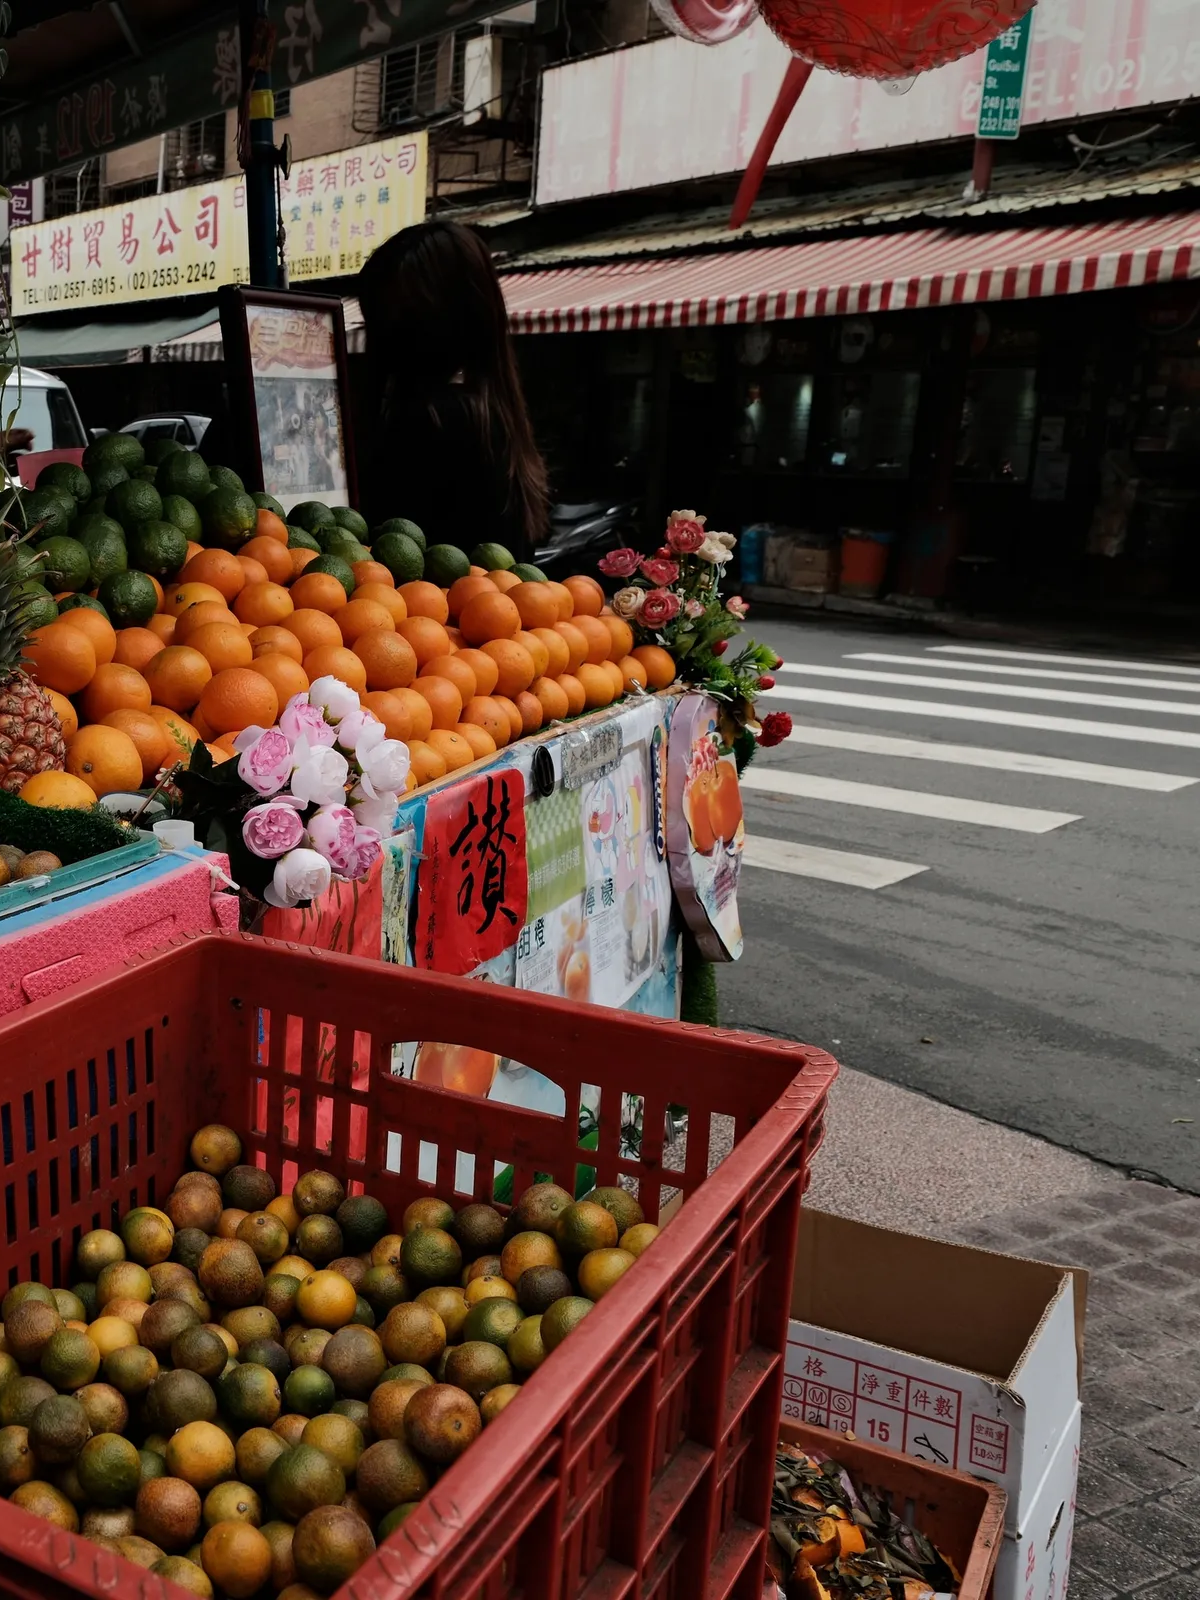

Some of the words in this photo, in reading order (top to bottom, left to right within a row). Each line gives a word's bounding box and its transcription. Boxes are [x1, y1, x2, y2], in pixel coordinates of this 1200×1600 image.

[987, 58, 1021, 72] GuiSui
[1026, 54, 1147, 110] EL:(02)
[21, 195, 219, 279] 甘樹貿易公司
[449, 774, 518, 935] 讚
[802, 1354, 827, 1378] 格
[861, 1373, 904, 1403] 淨重
[912, 1389, 955, 1420] 件數
[784, 1403, 800, 1418] 23
[867, 1418, 890, 1443] 15
